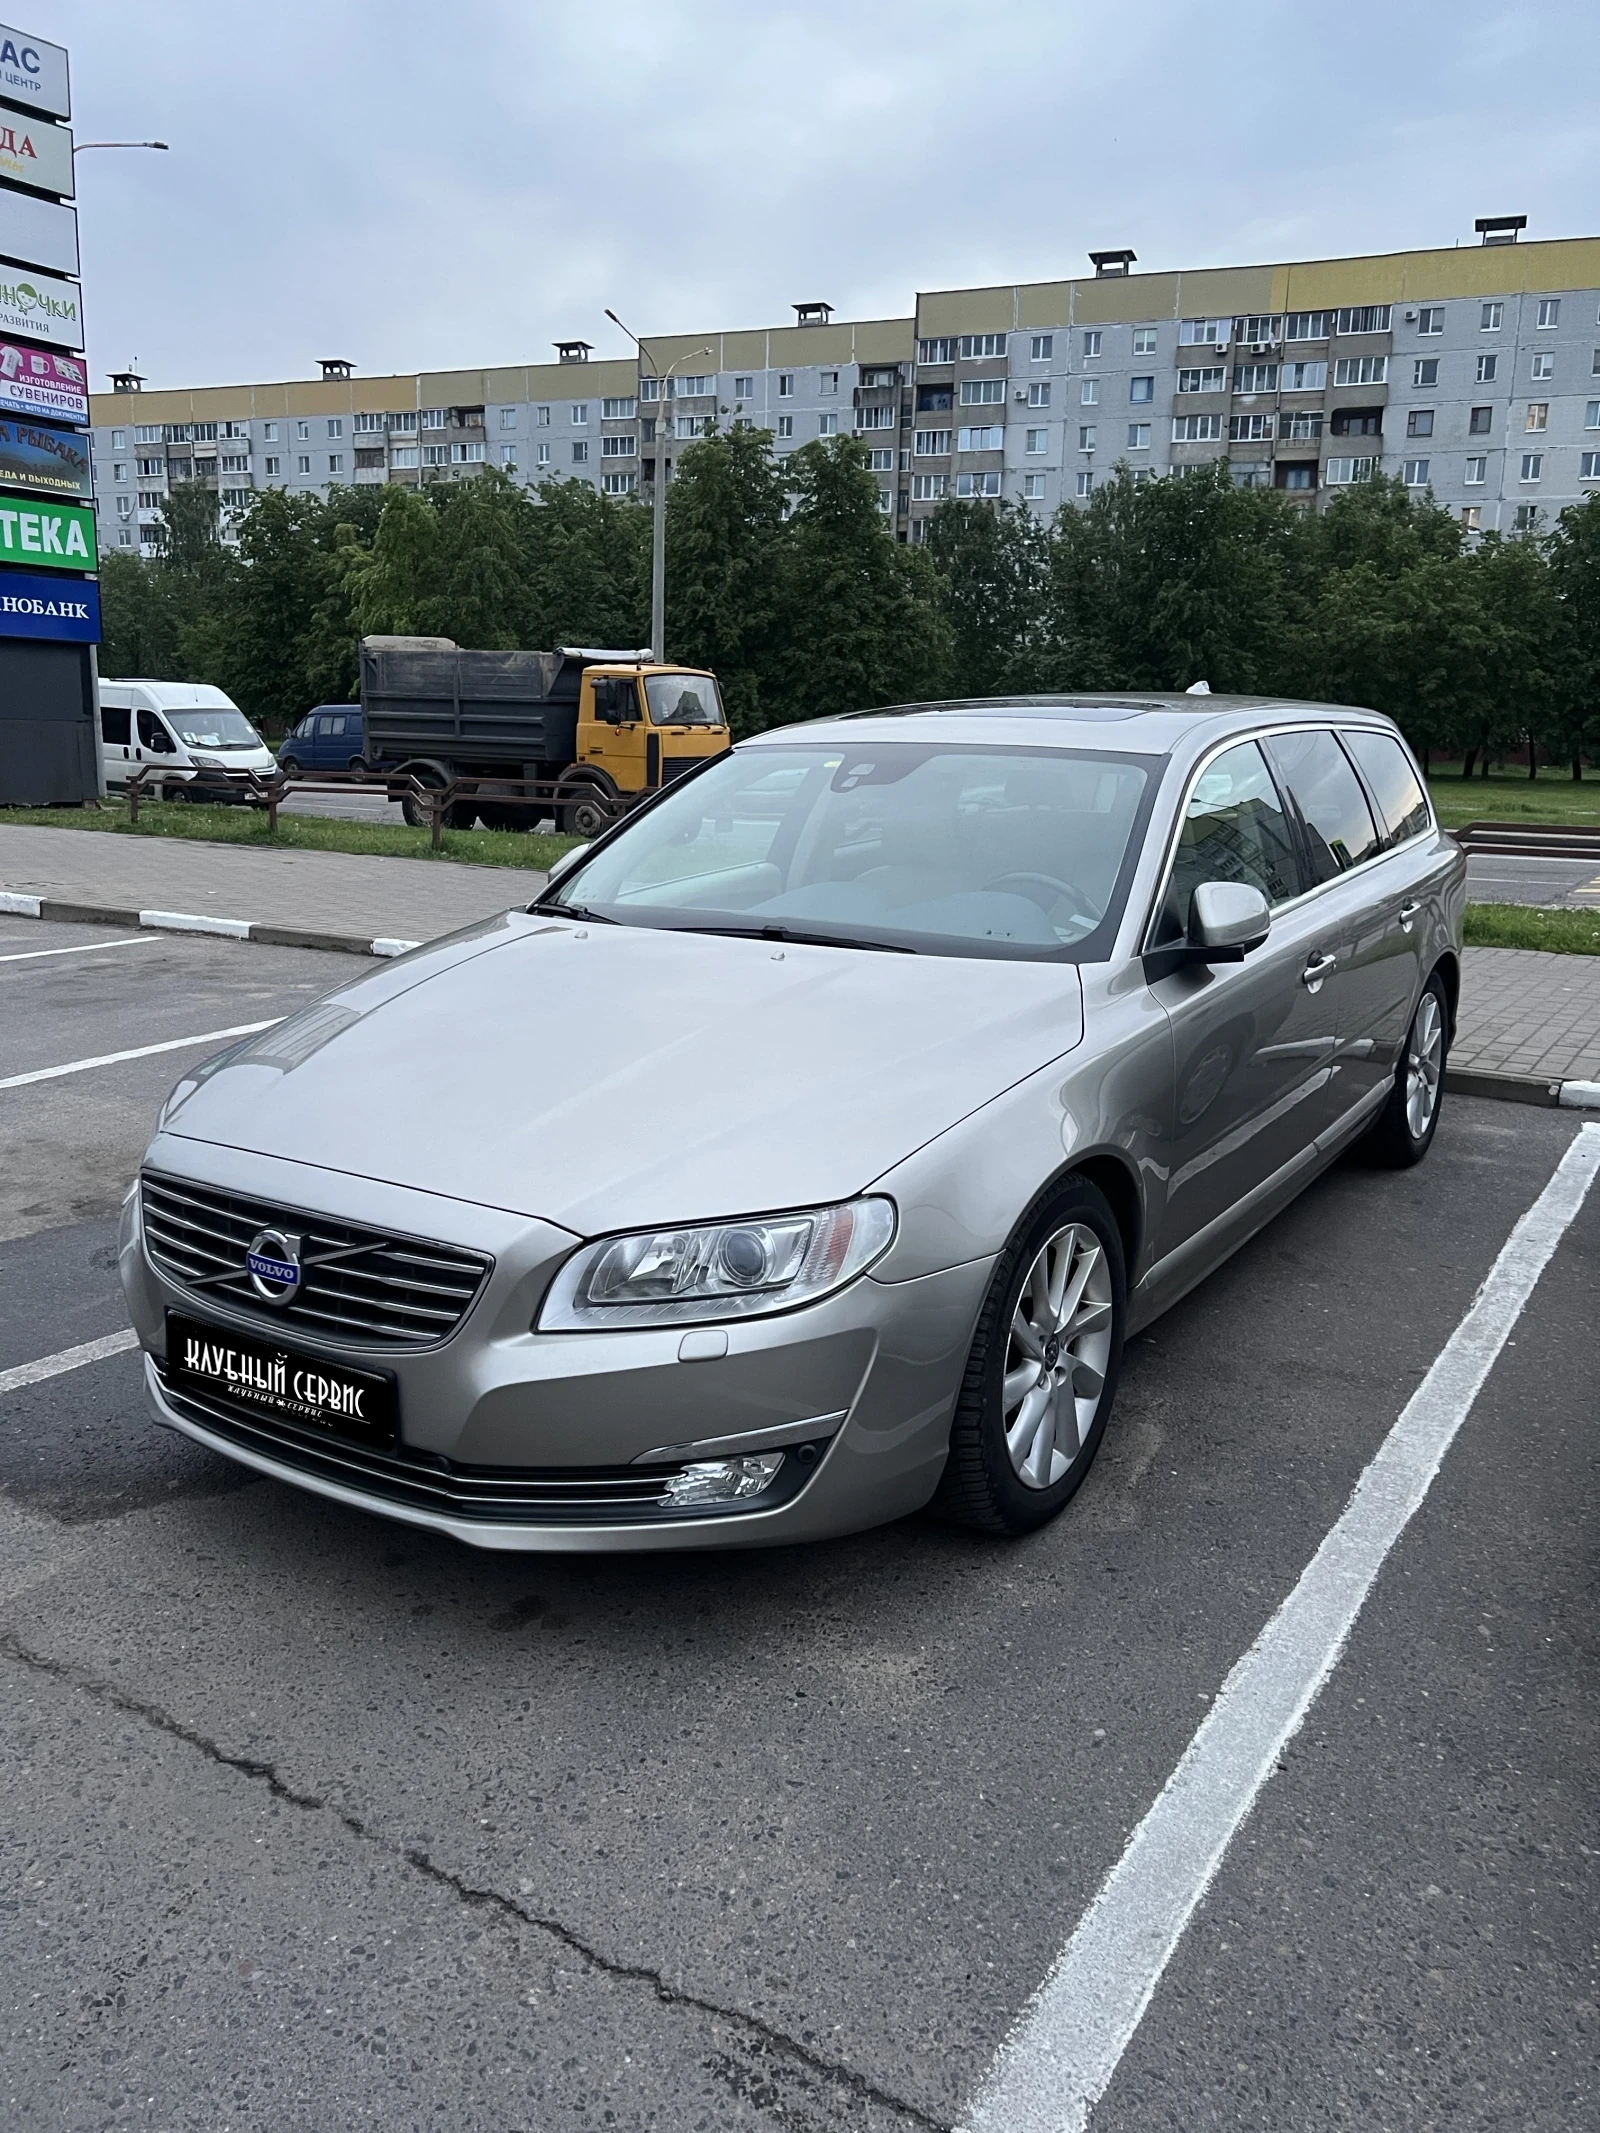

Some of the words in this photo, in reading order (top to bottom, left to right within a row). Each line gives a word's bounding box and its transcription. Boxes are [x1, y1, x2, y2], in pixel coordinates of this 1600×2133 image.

[0, 39, 40, 74] АС
[5, 72, 42, 92] ЦЕНТР
[0, 127, 38, 159] ДА
[0, 282, 77, 321] НОЧКИ
[19, 374, 82, 394] ИЗГОТОВЛЕНИЕ
[10, 385, 83, 409] СУВЕНИРОВ
[25, 404, 41, 413] ФОТО
[50, 410, 86, 421] ДОКУМЕНТЫ
[19, 473, 26, 481] И
[28, 474, 81, 490] ВЫХОДНЫХ
[0, 509, 89, 558] ТЕКА
[0, 597, 89, 619] НОБАНК
[249, 1258, 295, 1280] VOLVO
